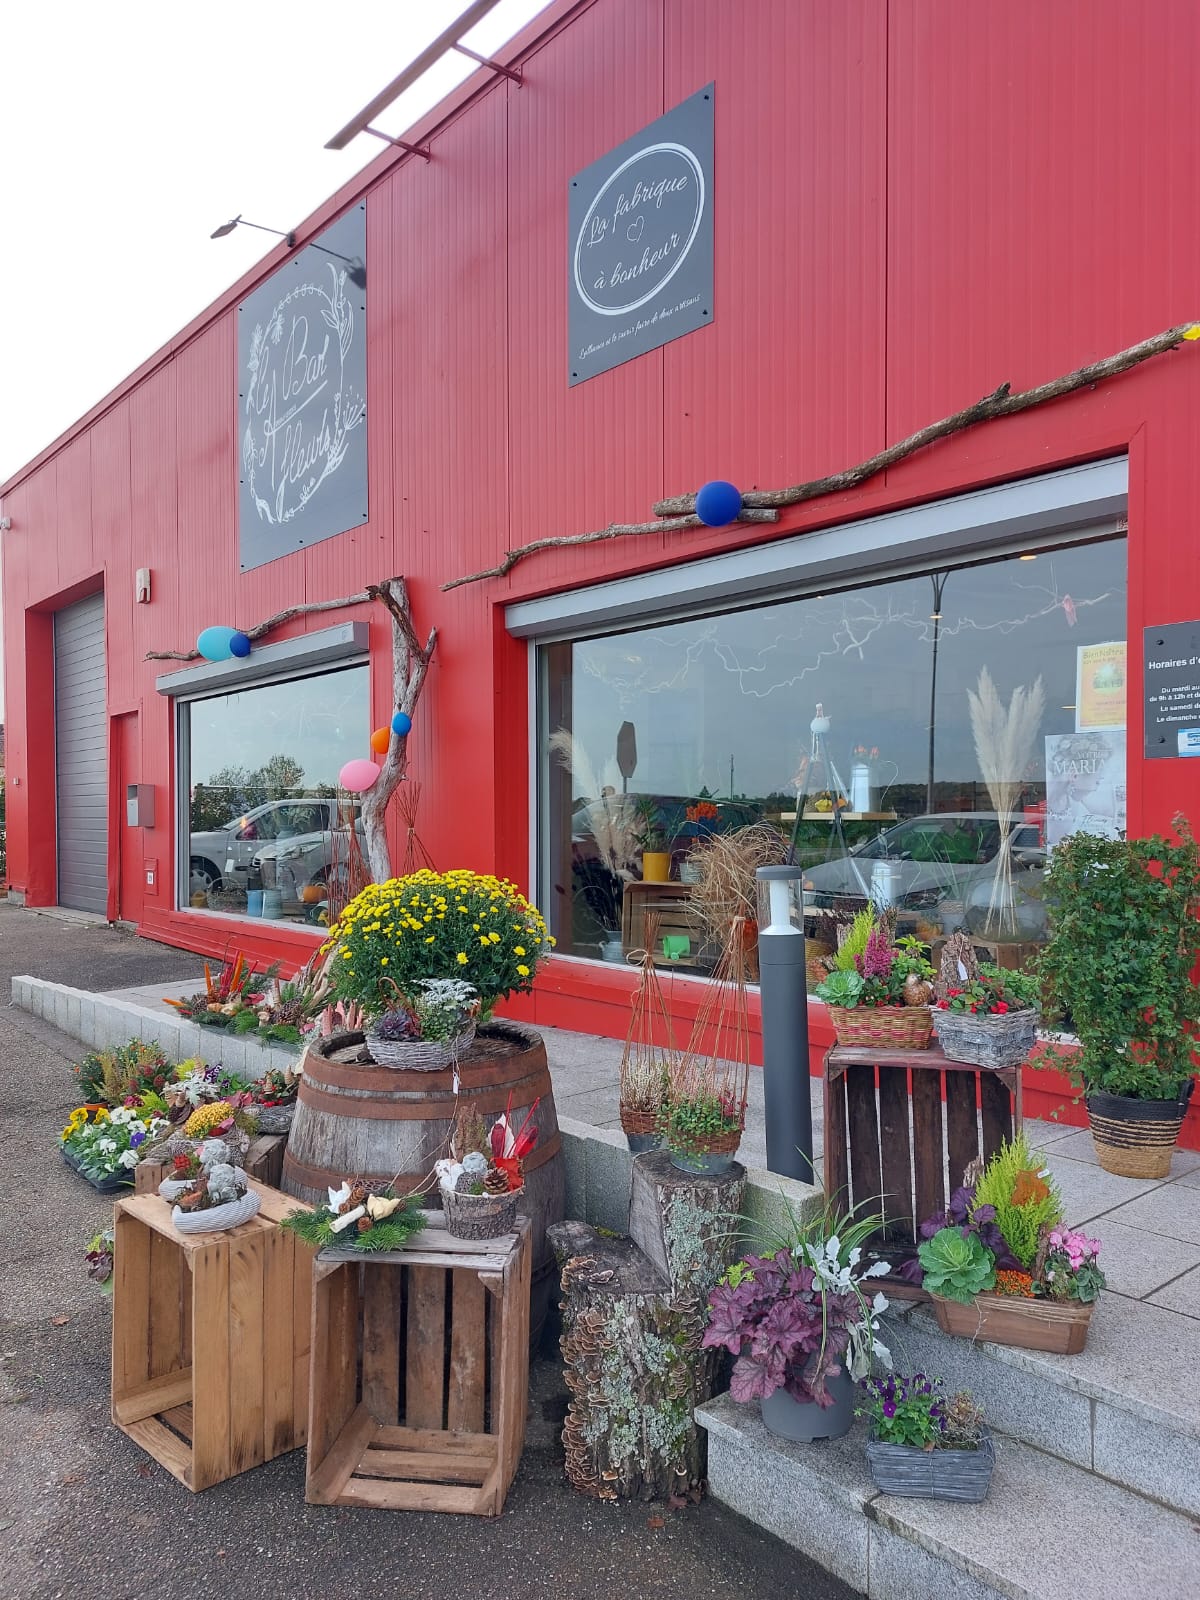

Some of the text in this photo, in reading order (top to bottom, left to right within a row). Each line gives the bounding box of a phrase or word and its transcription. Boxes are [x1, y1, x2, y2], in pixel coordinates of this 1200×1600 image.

[587, 175, 689, 249] La fabrique
[593, 231, 681, 289] à bonheur
[282, 314, 330, 401] Bar
[1148, 658, 1188, 670] Horaires
[1172, 684, 1191, 692] mardi
[1174, 692, 1186, 700] 12h
[1169, 703, 1193, 711] samedi
[1165, 713, 1198, 722] dimanche
